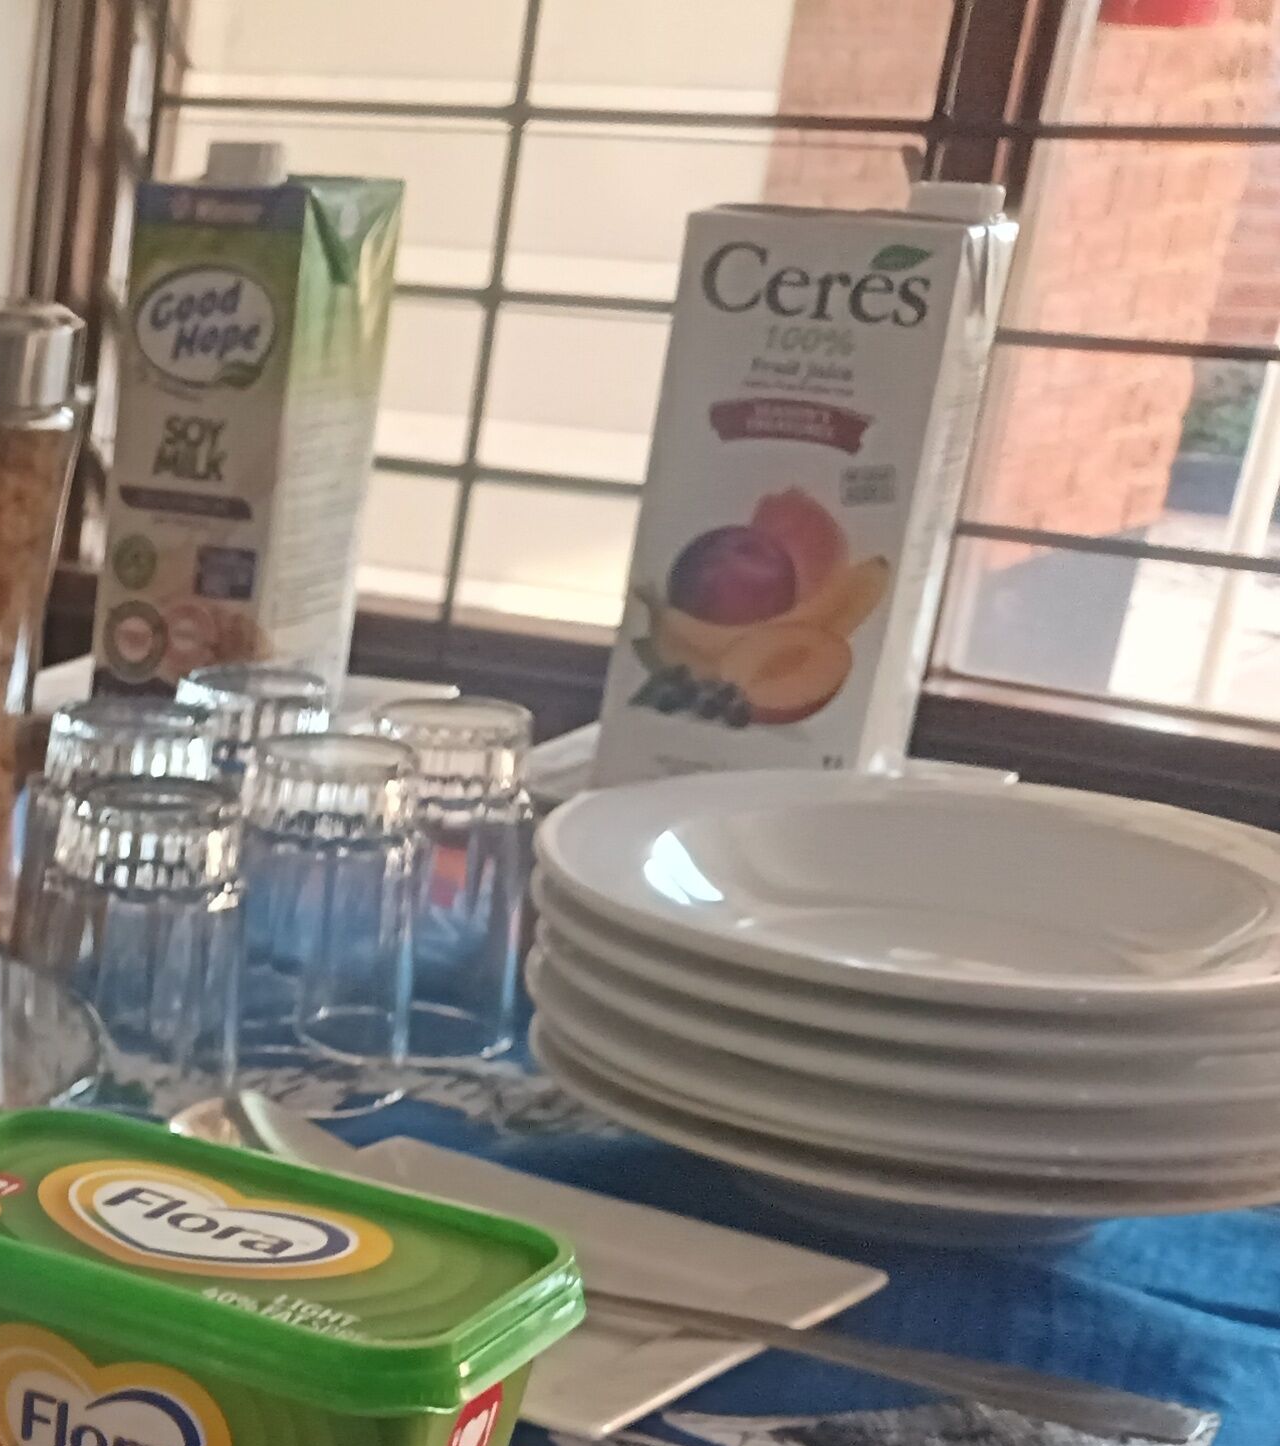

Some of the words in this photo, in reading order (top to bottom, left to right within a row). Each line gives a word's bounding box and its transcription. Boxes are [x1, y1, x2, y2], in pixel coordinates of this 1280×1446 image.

[702, 241, 931, 328] Ceres
[149, 276, 243, 331] Good
[170, 322, 261, 361] Hope
[766, 325, 854, 356] 100%
[165, 413, 227, 443] SOY
[153, 447, 226, 482] MILK
[102, 1186, 294, 1257] Flora
[273, 1293, 361, 1328] LIGHT
